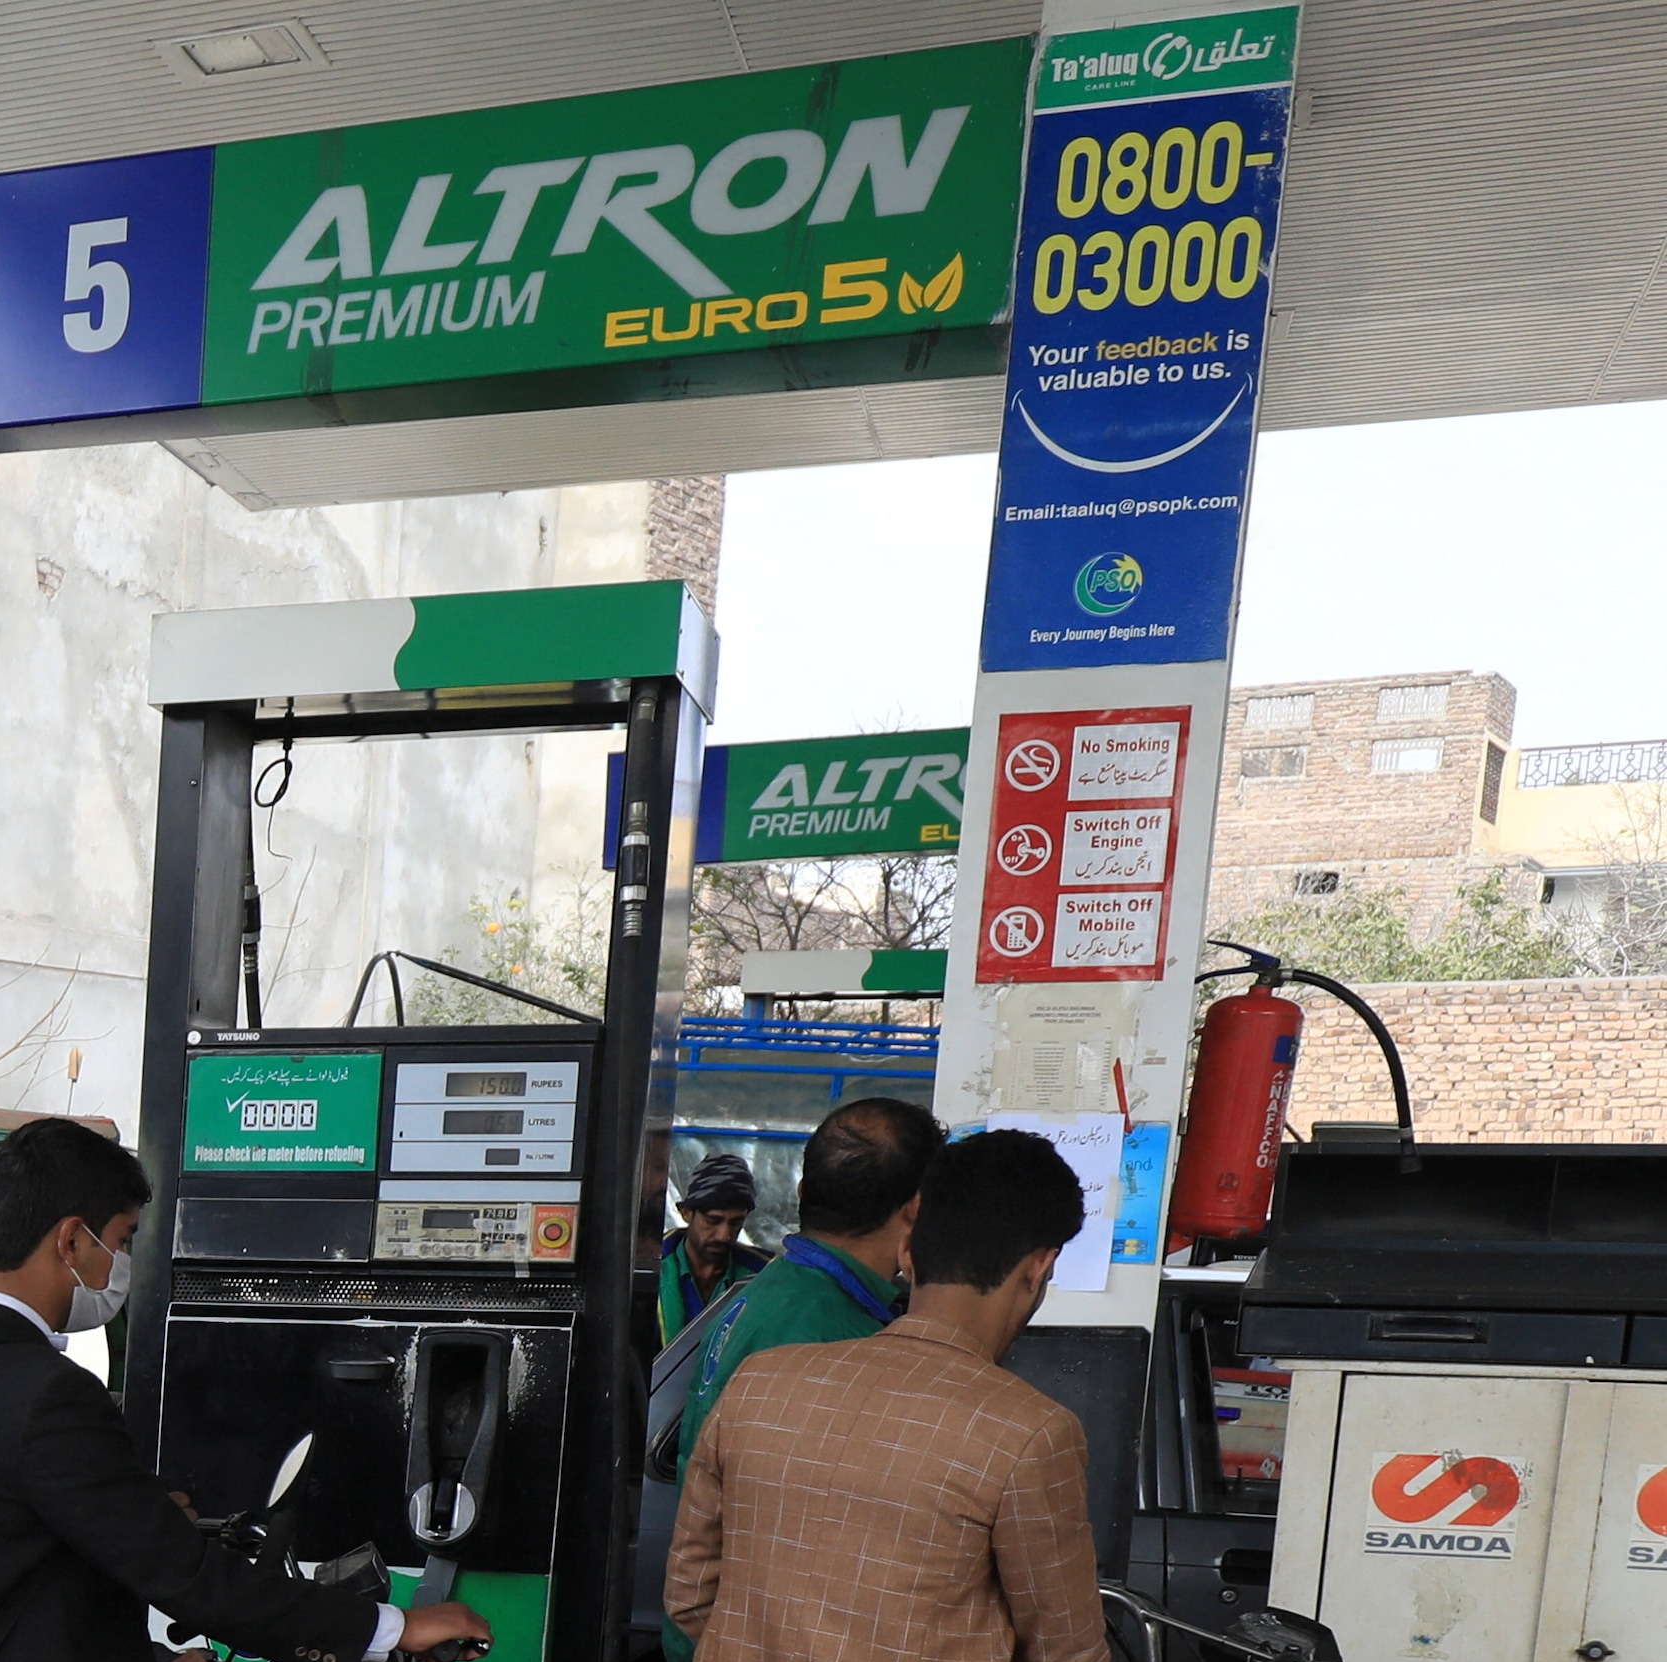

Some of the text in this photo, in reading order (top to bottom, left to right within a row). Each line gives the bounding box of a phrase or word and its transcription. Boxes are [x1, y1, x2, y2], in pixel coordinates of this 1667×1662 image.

[1051, 52, 1138, 83] Ta'aluq
[1084, 79, 1137, 91] CARE LINE
[1055, 120, 1275, 219] 0800-
[252, 105, 972, 296] ALTRON
[1032, 216, 1263, 314] 03000
[62, 214, 129, 354] 5
[247, 272, 547, 355] PREMIUM
[604, 293, 810, 352] EURO
[1028, 329, 1250, 367] Your feedback is
[1038, 361, 1232, 392] valuable to us.
[1004, 496, 1238, 522] Email:taaluq@psopk.com
[1090, 568, 1138, 594] PSO
[1030, 623, 1176, 644] Every Journey Begins Here
[1080, 736, 1170, 754] No Smoking
[750, 752, 967, 822] ALTR
[748, 806, 892, 839] PREMIUM
[1073, 815, 1162, 832] Switch Off
[1091, 835, 1143, 851] Engine
[1065, 898, 1153, 914] Switch Off
[1078, 918, 1135, 932] Mobile
[217, 1032, 260, 1042] TATSUNO
[530, 1079, 564, 1088] RUPEES
[528, 1117, 556, 1126] LITRES
[1256, 1084, 1282, 1169] NAFFCO
[194, 1145, 365, 1164] Please check the meter before refueling
[1364, 1531, 1513, 1553] SAMOA
